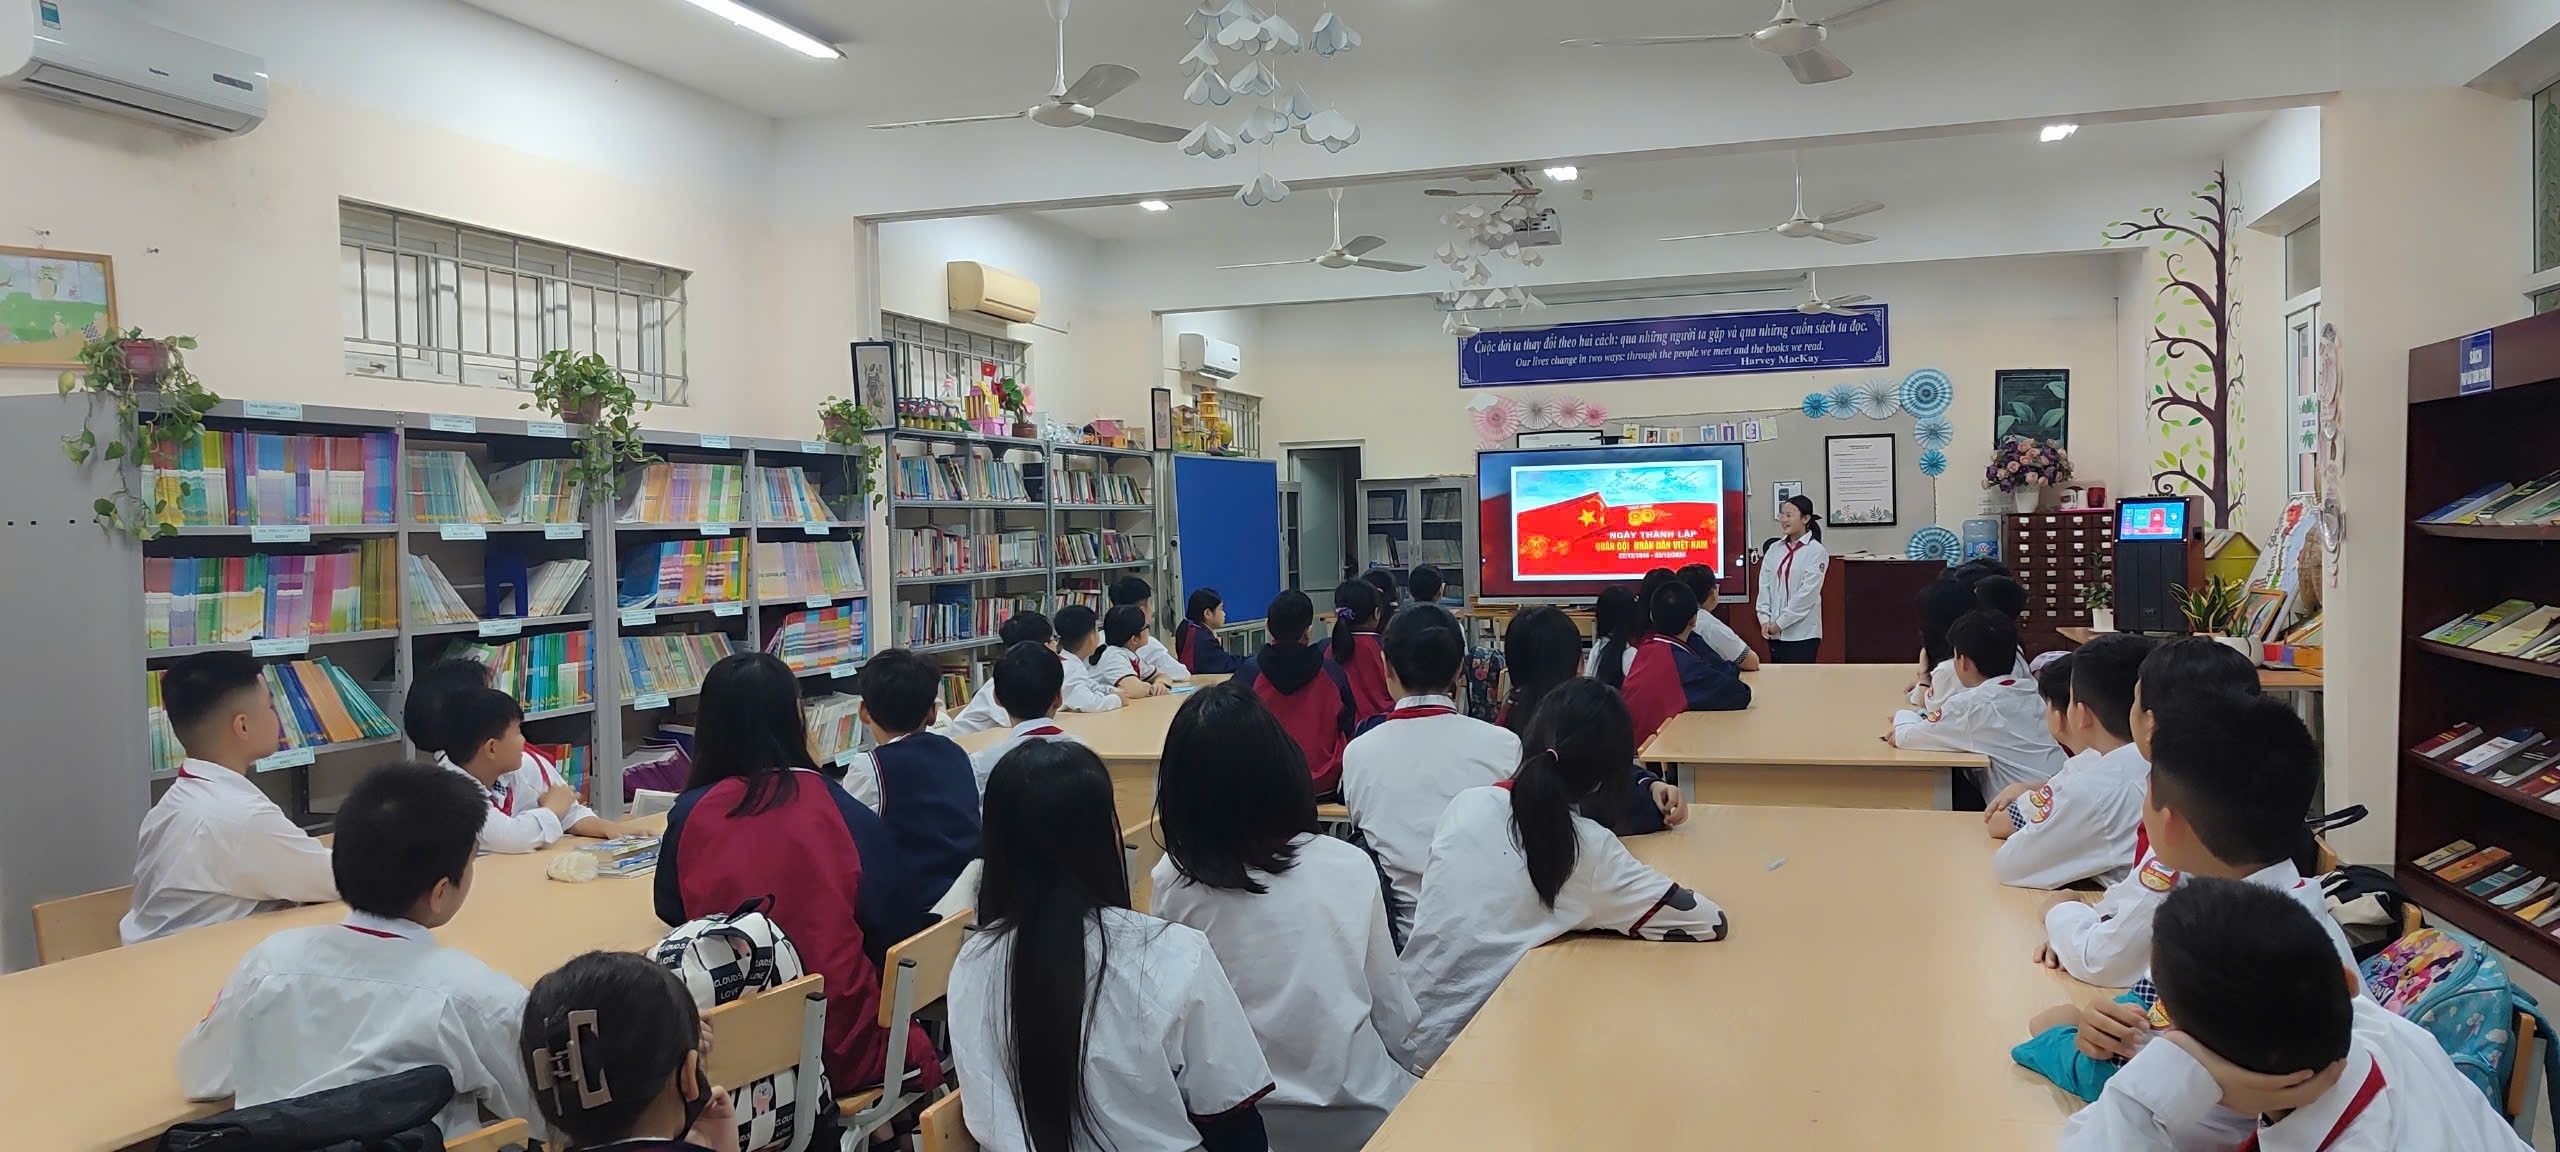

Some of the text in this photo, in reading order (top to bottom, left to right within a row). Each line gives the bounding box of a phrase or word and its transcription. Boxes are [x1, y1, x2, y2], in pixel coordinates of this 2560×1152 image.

[1474, 317, 1868, 356] Cuộc đời ta thay đổi theo hai cách: qua những người ta gặp và qua những cuốn sách ta đọc.
[1515, 340, 1824, 368] Our lives change in two ways: through the people we meet and the books we read.
[1741, 354, 1819, 367] Harvey MacKay
[1691, 539, 1708, 550] NAM
[714, 972, 744, 988] CLOUDS
[749, 971, 766, 981] LOVE
